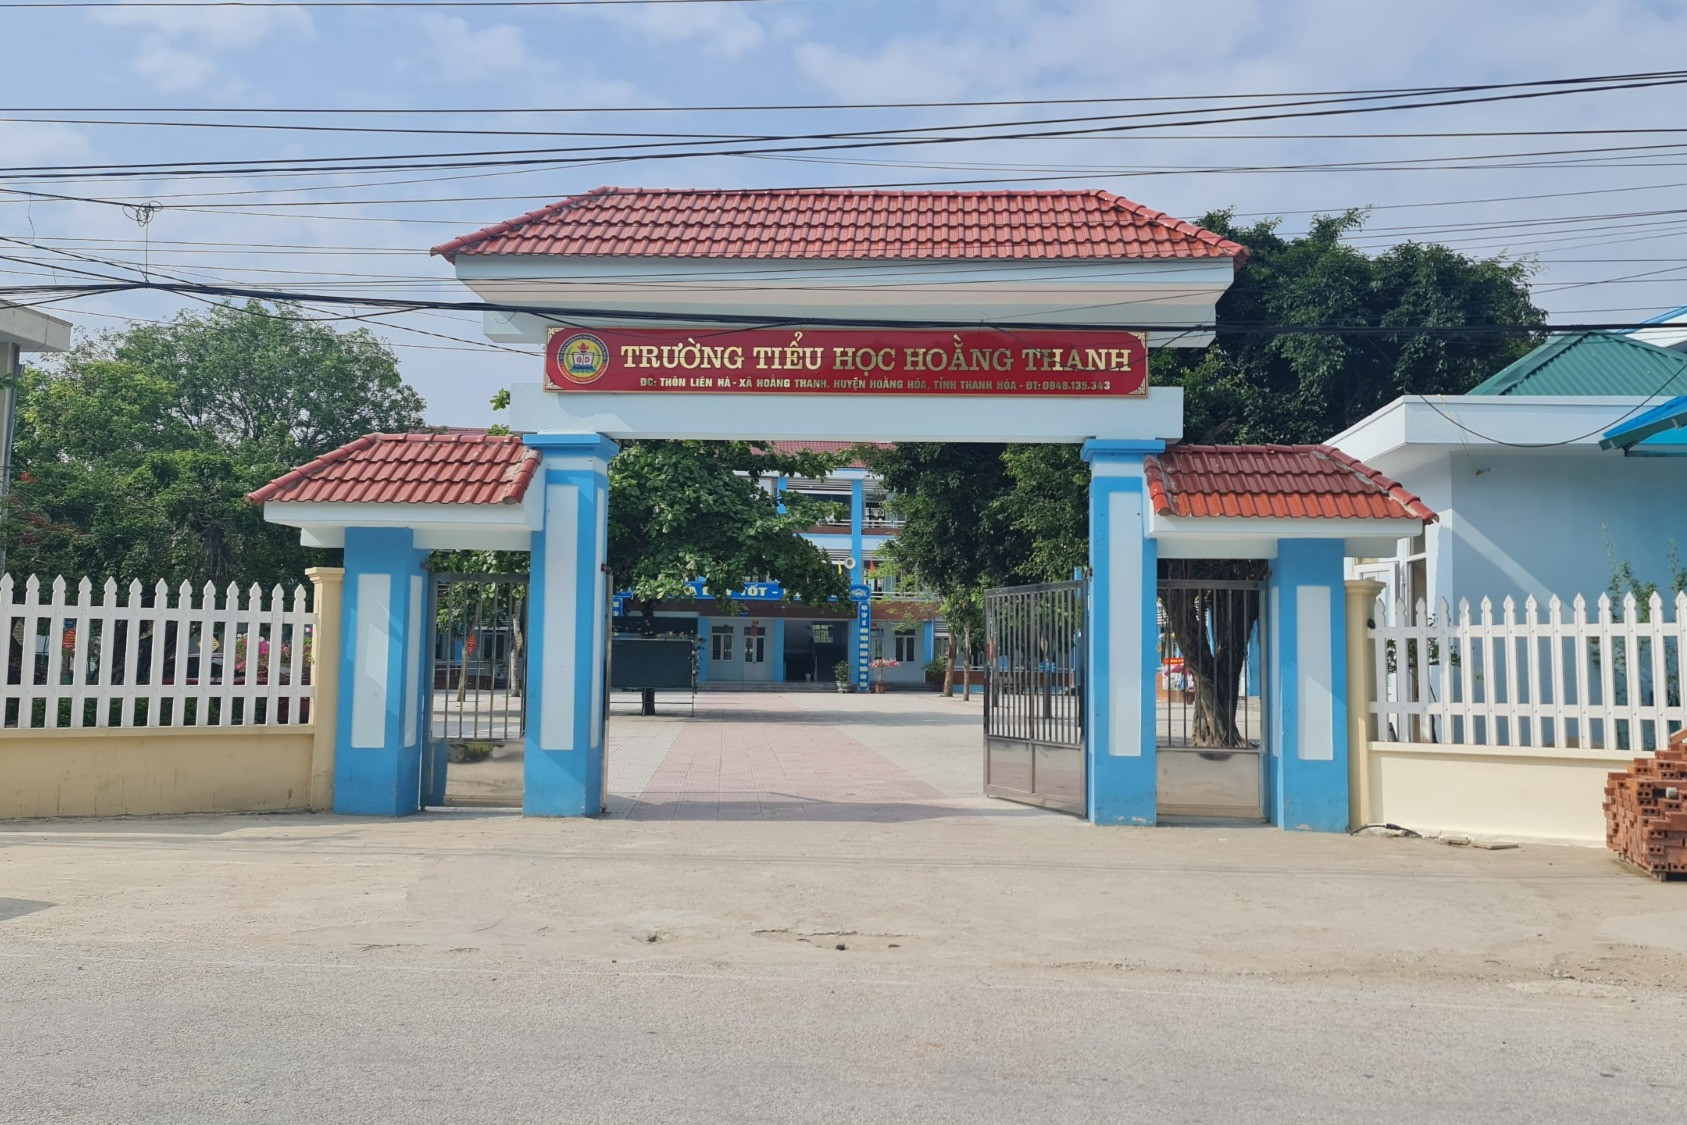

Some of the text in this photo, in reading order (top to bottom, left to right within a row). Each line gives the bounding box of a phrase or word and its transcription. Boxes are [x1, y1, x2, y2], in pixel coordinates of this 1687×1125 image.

[621, 338, 744, 369] TRƯỜNG
[753, 331, 824, 370] TIỂU
[833, 348, 895, 376] HỌC
[904, 334, 1014, 371] HOẰNG
[1022, 348, 1131, 372] THANH
[640, 378, 657, 387] ĐC:
[660, 376, 686, 387] THÔN
[690, 376, 712, 388] LIÊN
[718, 376, 731, 388] HÀ
[739, 376, 752, 388] XÃ
[756, 375, 790, 388] HOẰNG
[834, 377, 866, 390] HUYỆN
[870, 376, 904, 389] HOẰNG
[934, 377, 956, 390] TỈNH
[960, 380, 992, 390] THANH
[997, 379, 1017, 390] HÓA
